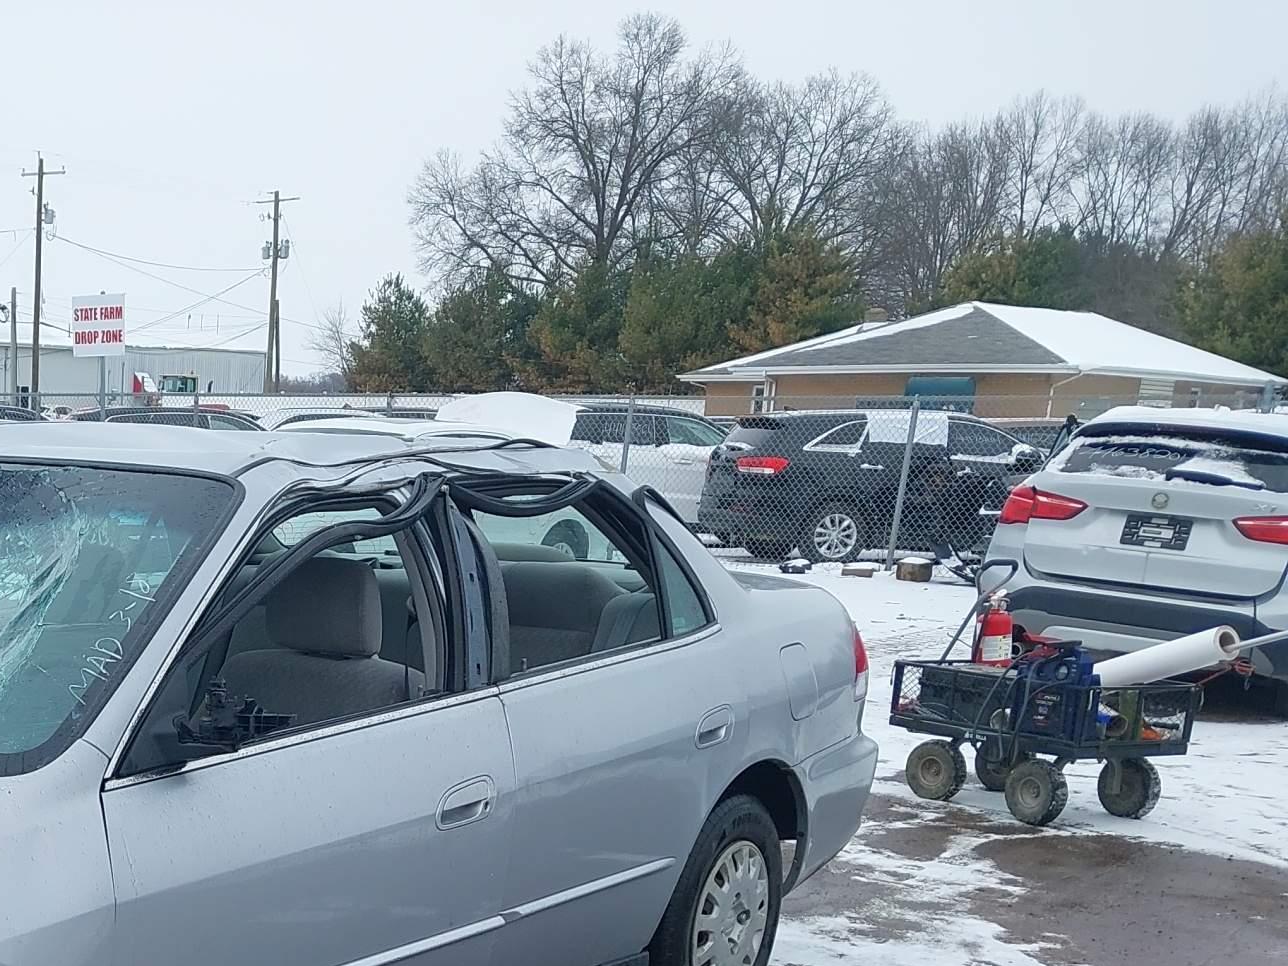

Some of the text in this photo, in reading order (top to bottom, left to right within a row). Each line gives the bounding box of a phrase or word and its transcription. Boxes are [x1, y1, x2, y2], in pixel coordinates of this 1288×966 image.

[73, 306, 123, 322] STATE FARM
[74, 329, 123, 344] DROP ZONE
